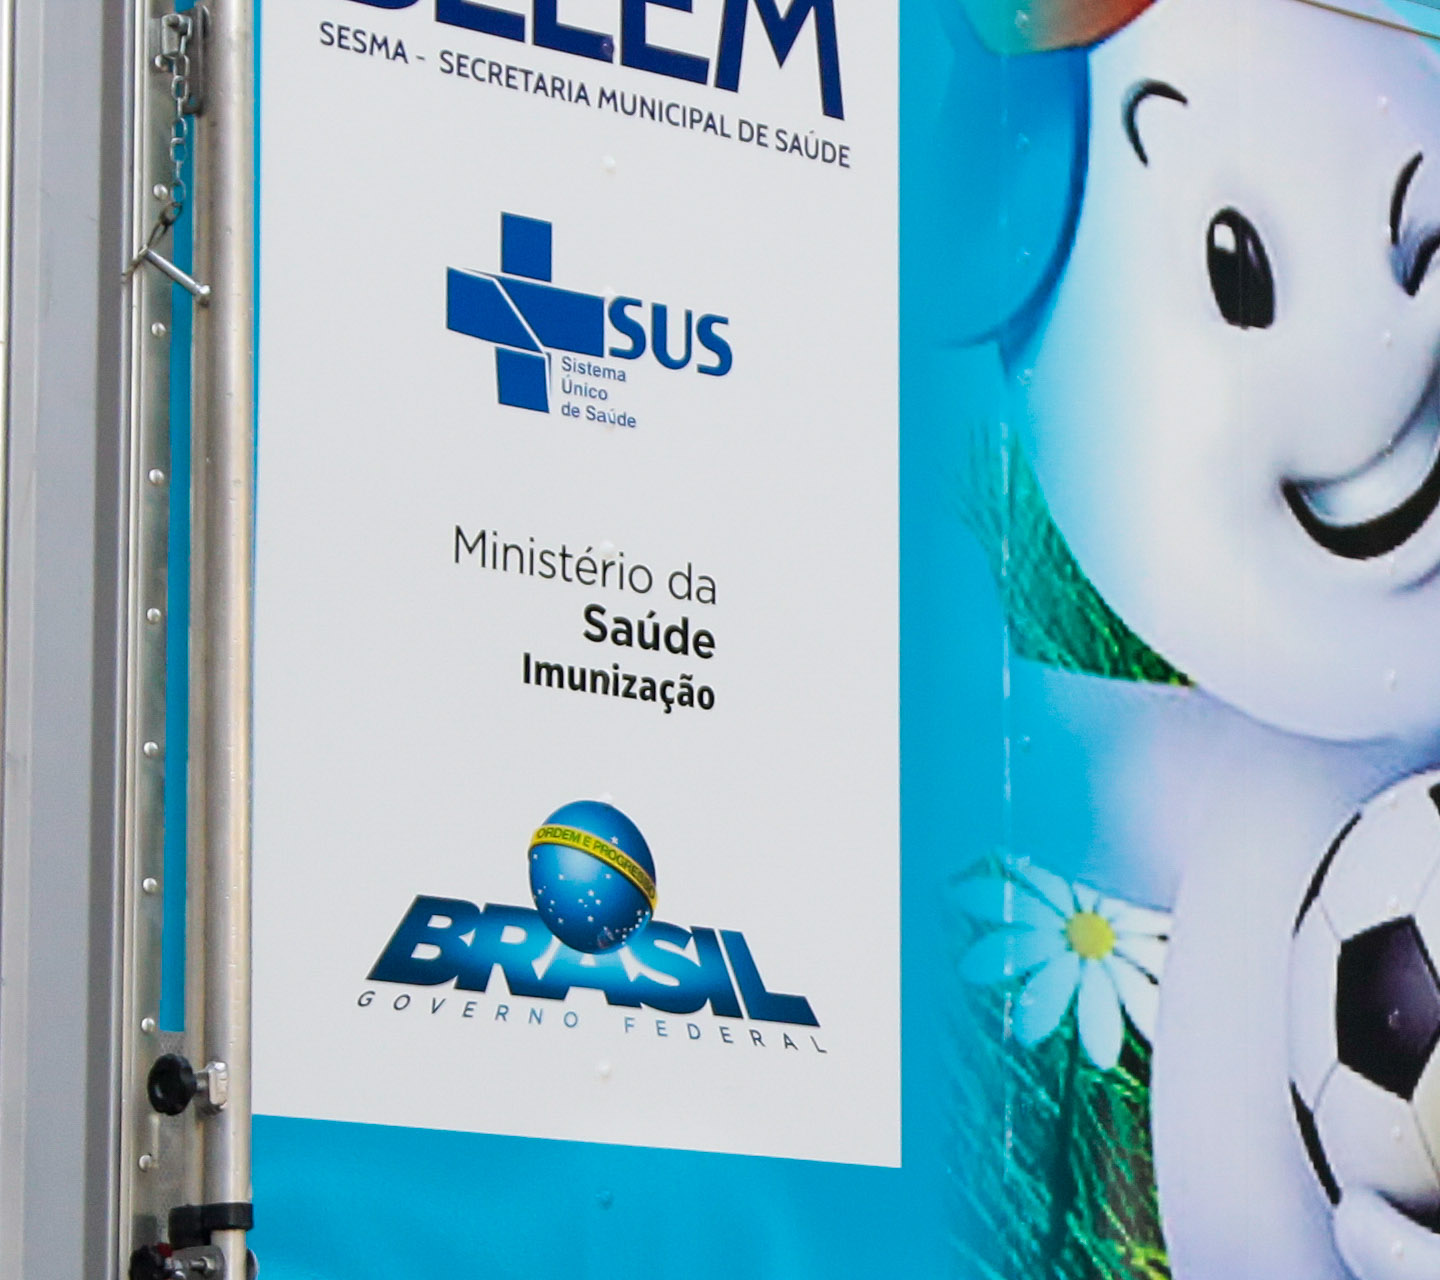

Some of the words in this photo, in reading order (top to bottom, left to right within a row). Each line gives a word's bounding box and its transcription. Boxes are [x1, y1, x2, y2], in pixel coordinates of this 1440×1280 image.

[319, 21, 409, 65] SESMA
[440, 50, 590, 108] SECRETARIA
[599, 87, 730, 139] MUNICIPAL
[738, 119, 768, 148] DE
[776, 129, 851, 169] SAÚDE
[607, 293, 732, 377] SUS
[561, 355, 626, 383] Sistema
[561, 375, 608, 401] Único
[561, 400, 581, 420] de
[585, 404, 637, 430] Saúde
[454, 525, 654, 597] Ministério
[668, 563, 718, 606] da
[583, 603, 716, 660] Saúde
[522, 652, 715, 713] Imunização
[537, 827, 581, 844] ORDEM
[582, 835, 593, 848] E
[368, 894, 819, 1028] BRASIL
[357, 990, 579, 1029] GOVERNO
[625, 1016, 827, 1054] FEDERAL
